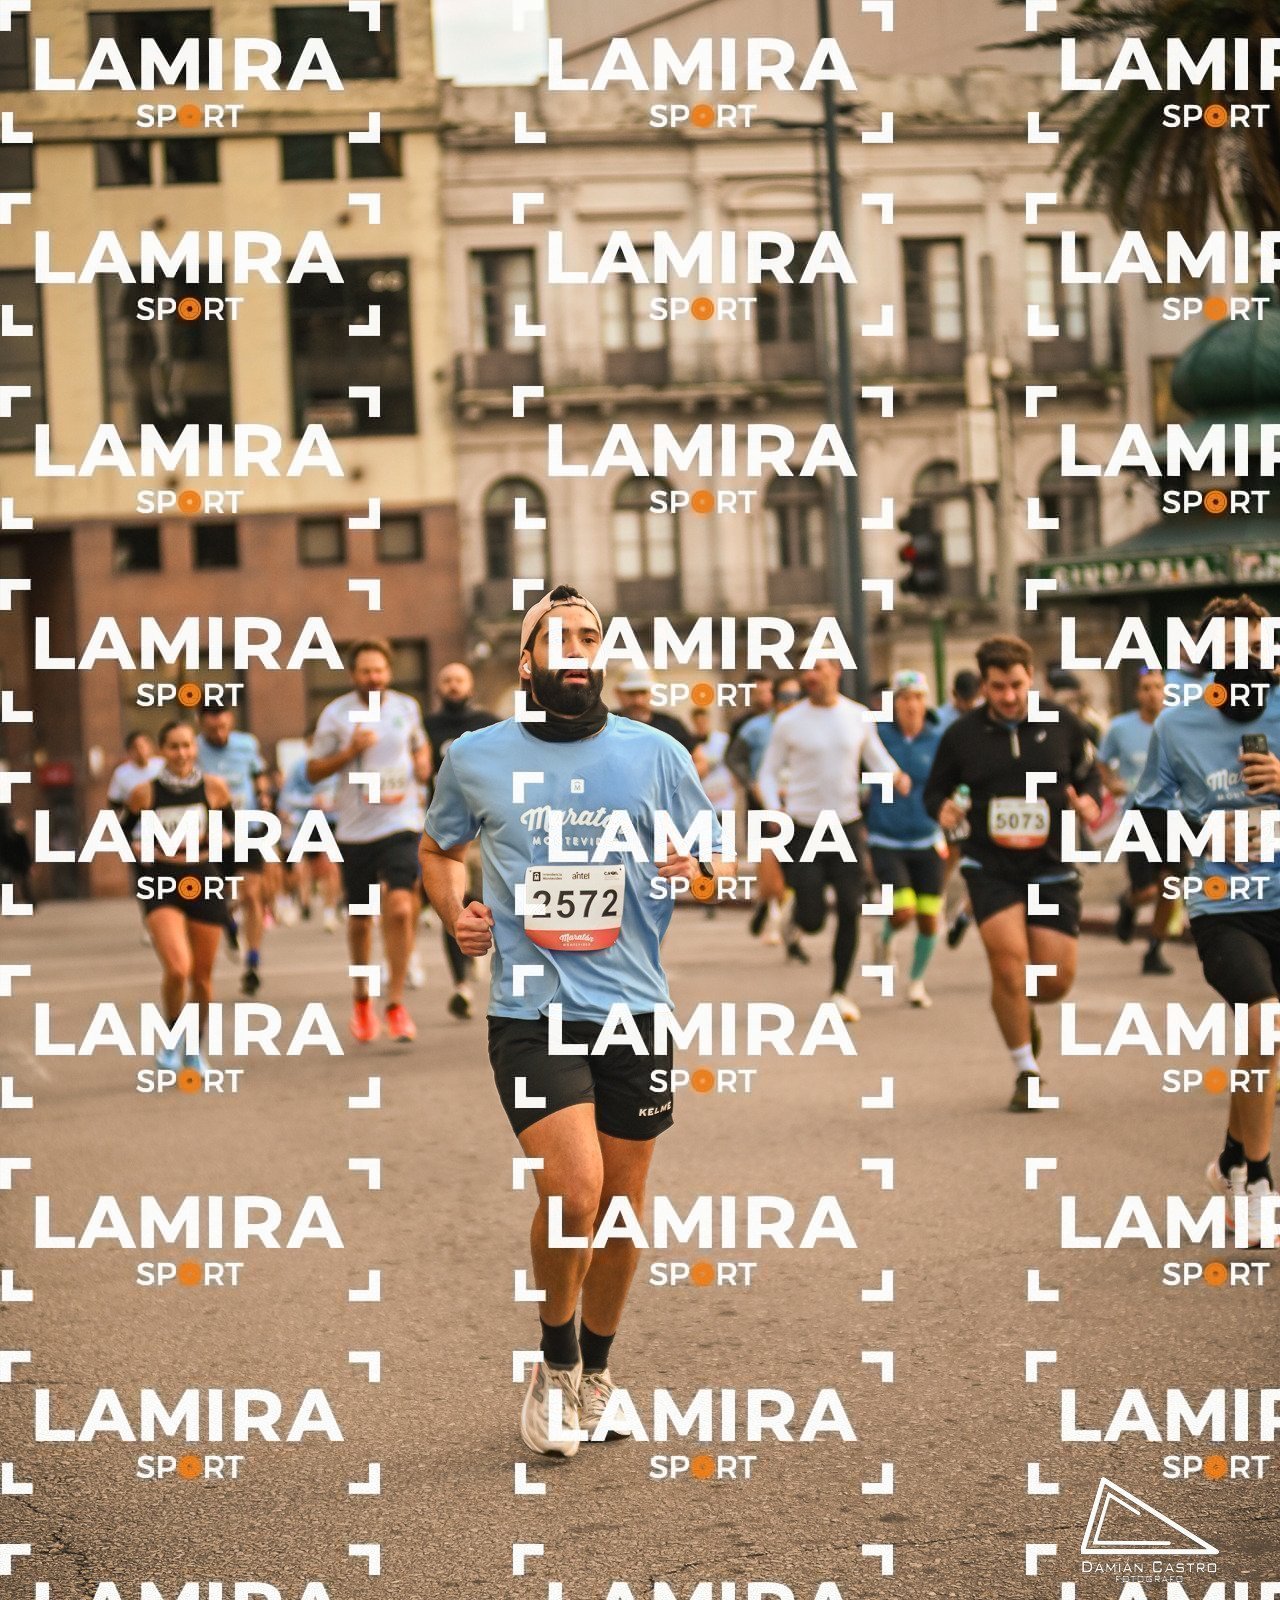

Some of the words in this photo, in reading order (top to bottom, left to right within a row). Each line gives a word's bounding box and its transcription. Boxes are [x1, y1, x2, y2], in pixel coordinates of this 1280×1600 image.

[995, 813, 1045, 829] 5073
[572, 872, 590, 880] antel
[532, 889, 618, 918] 2572
[638, 1101, 672, 1117] KELME
